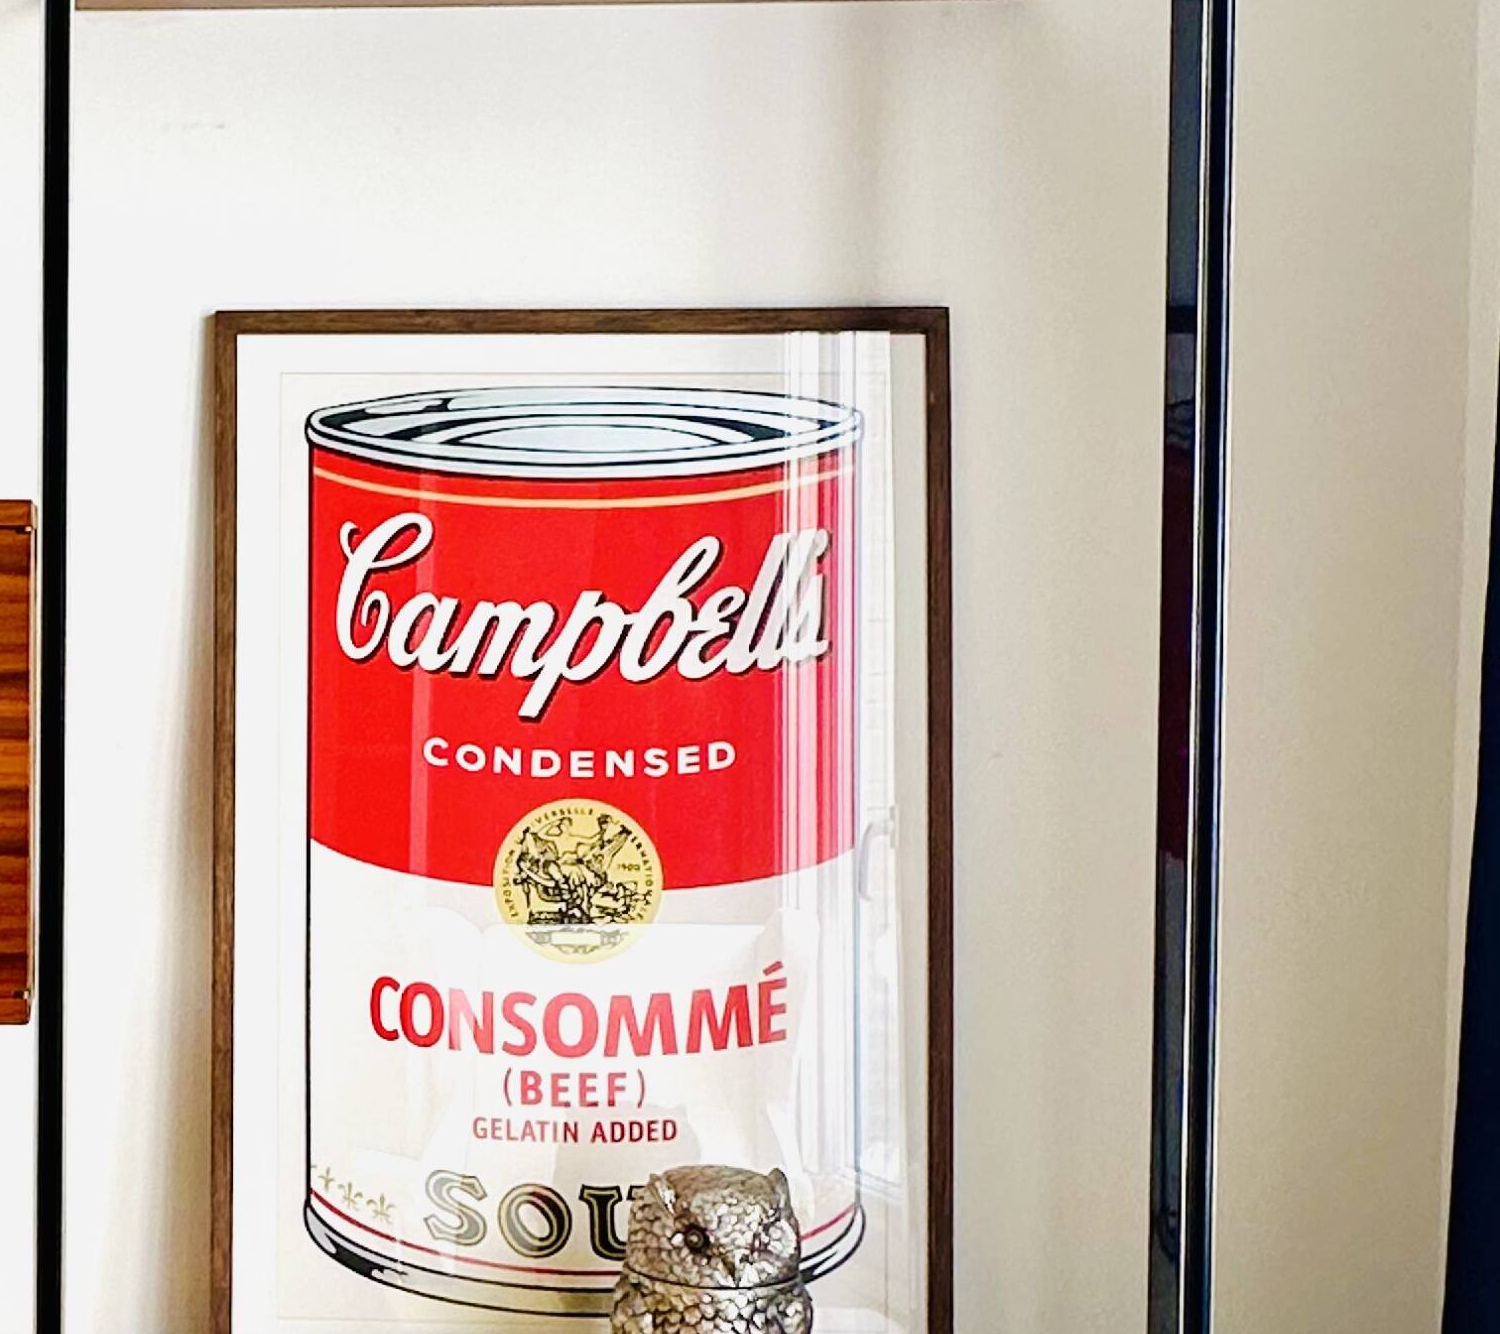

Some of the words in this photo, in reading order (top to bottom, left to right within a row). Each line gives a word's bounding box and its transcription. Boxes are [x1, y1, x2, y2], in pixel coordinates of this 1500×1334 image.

[423, 736, 737, 778] CONDENSED
[369, 961, 788, 1059] CONSOMMÉ
[503, 1069, 647, 1110] (BEEF)
[472, 1116, 579, 1144] GELATIN
[590, 1118, 678, 1144] ADDED
[423, 1169, 647, 1261] SOU
